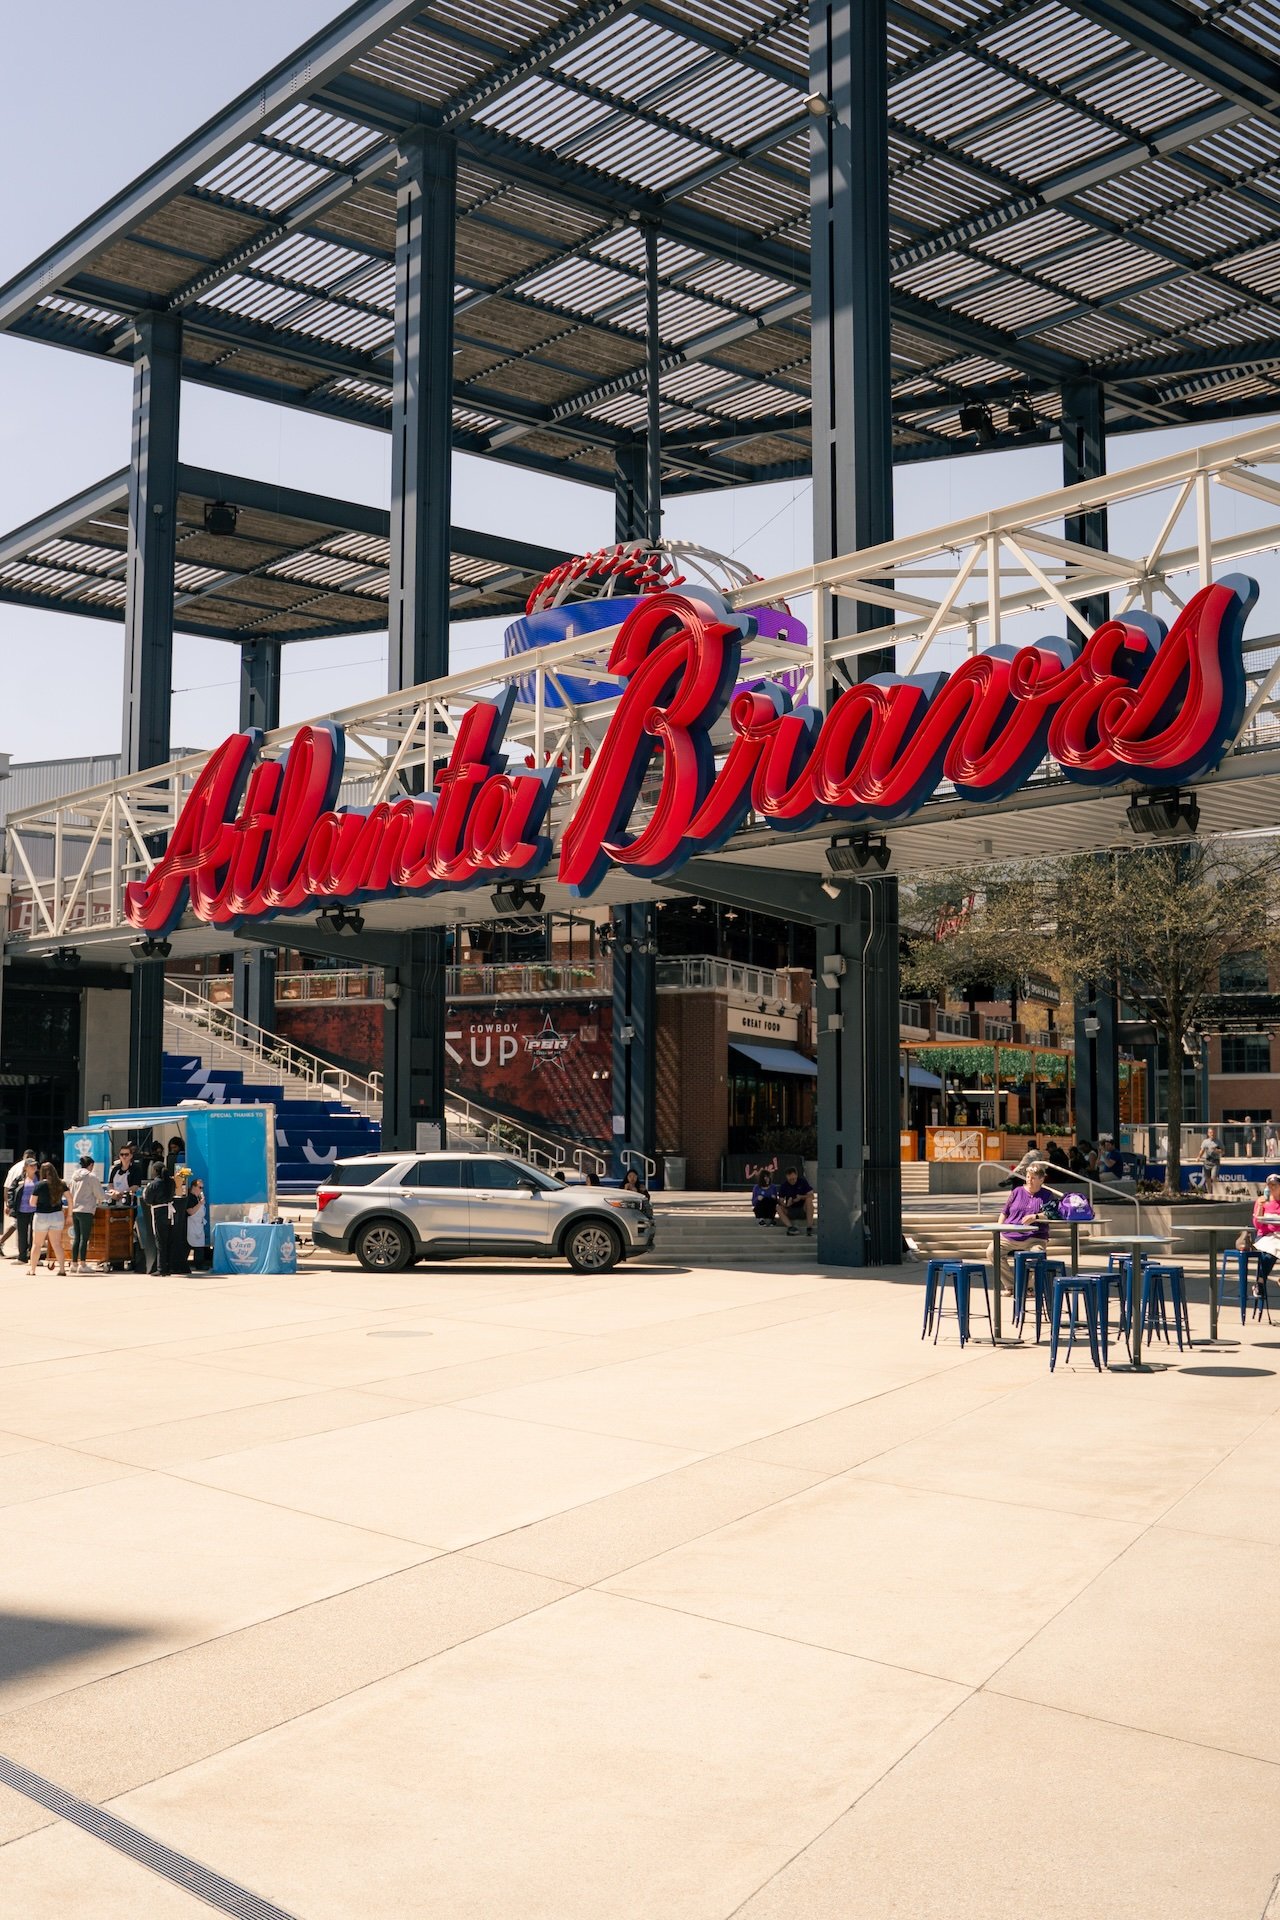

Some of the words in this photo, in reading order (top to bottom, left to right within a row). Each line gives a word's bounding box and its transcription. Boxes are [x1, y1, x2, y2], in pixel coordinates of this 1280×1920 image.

[125, 694, 558, 937] Atlanta
[558, 574, 1259, 897] Braves
[470, 1023, 518, 1034] COWBOY
[742, 1017, 762, 1029] GREAT
[764, 1021, 780, 1032] FOOD
[470, 1035, 519, 1067] UP
[528, 1040, 569, 1050] PBR
[1216, 1174, 1248, 1182] NDUEL
